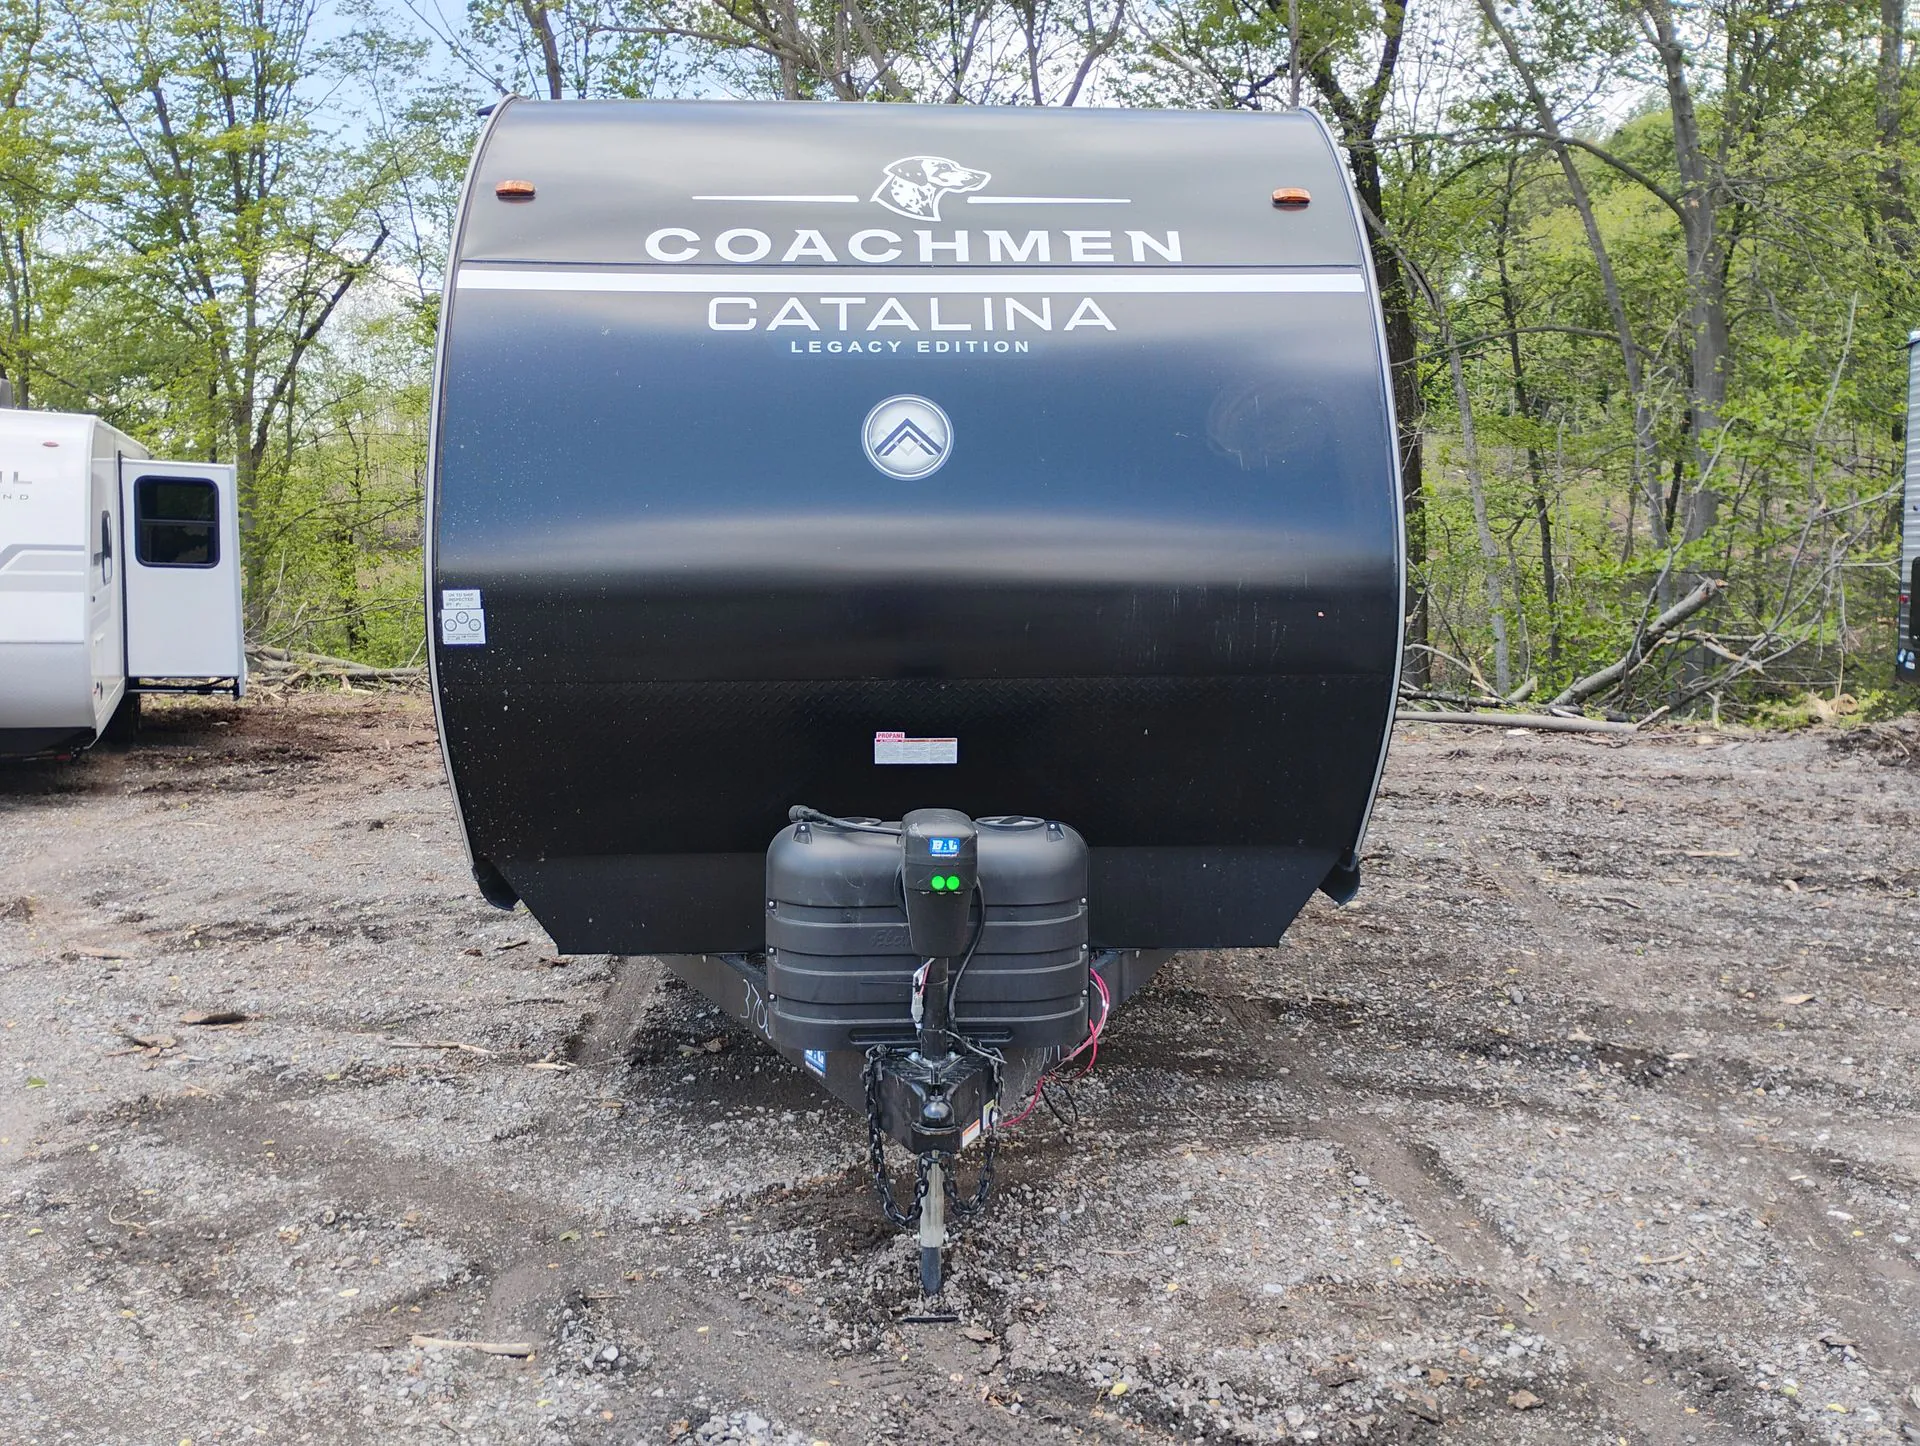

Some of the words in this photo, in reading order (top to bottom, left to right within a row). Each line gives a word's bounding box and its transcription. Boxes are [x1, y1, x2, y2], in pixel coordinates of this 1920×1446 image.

[644, 227, 1184, 263] COACHMEN
[707, 297, 1118, 332] CATALINA
[790, 340, 902, 354] LEGACY
[916, 340, 1031, 354] EDITION
